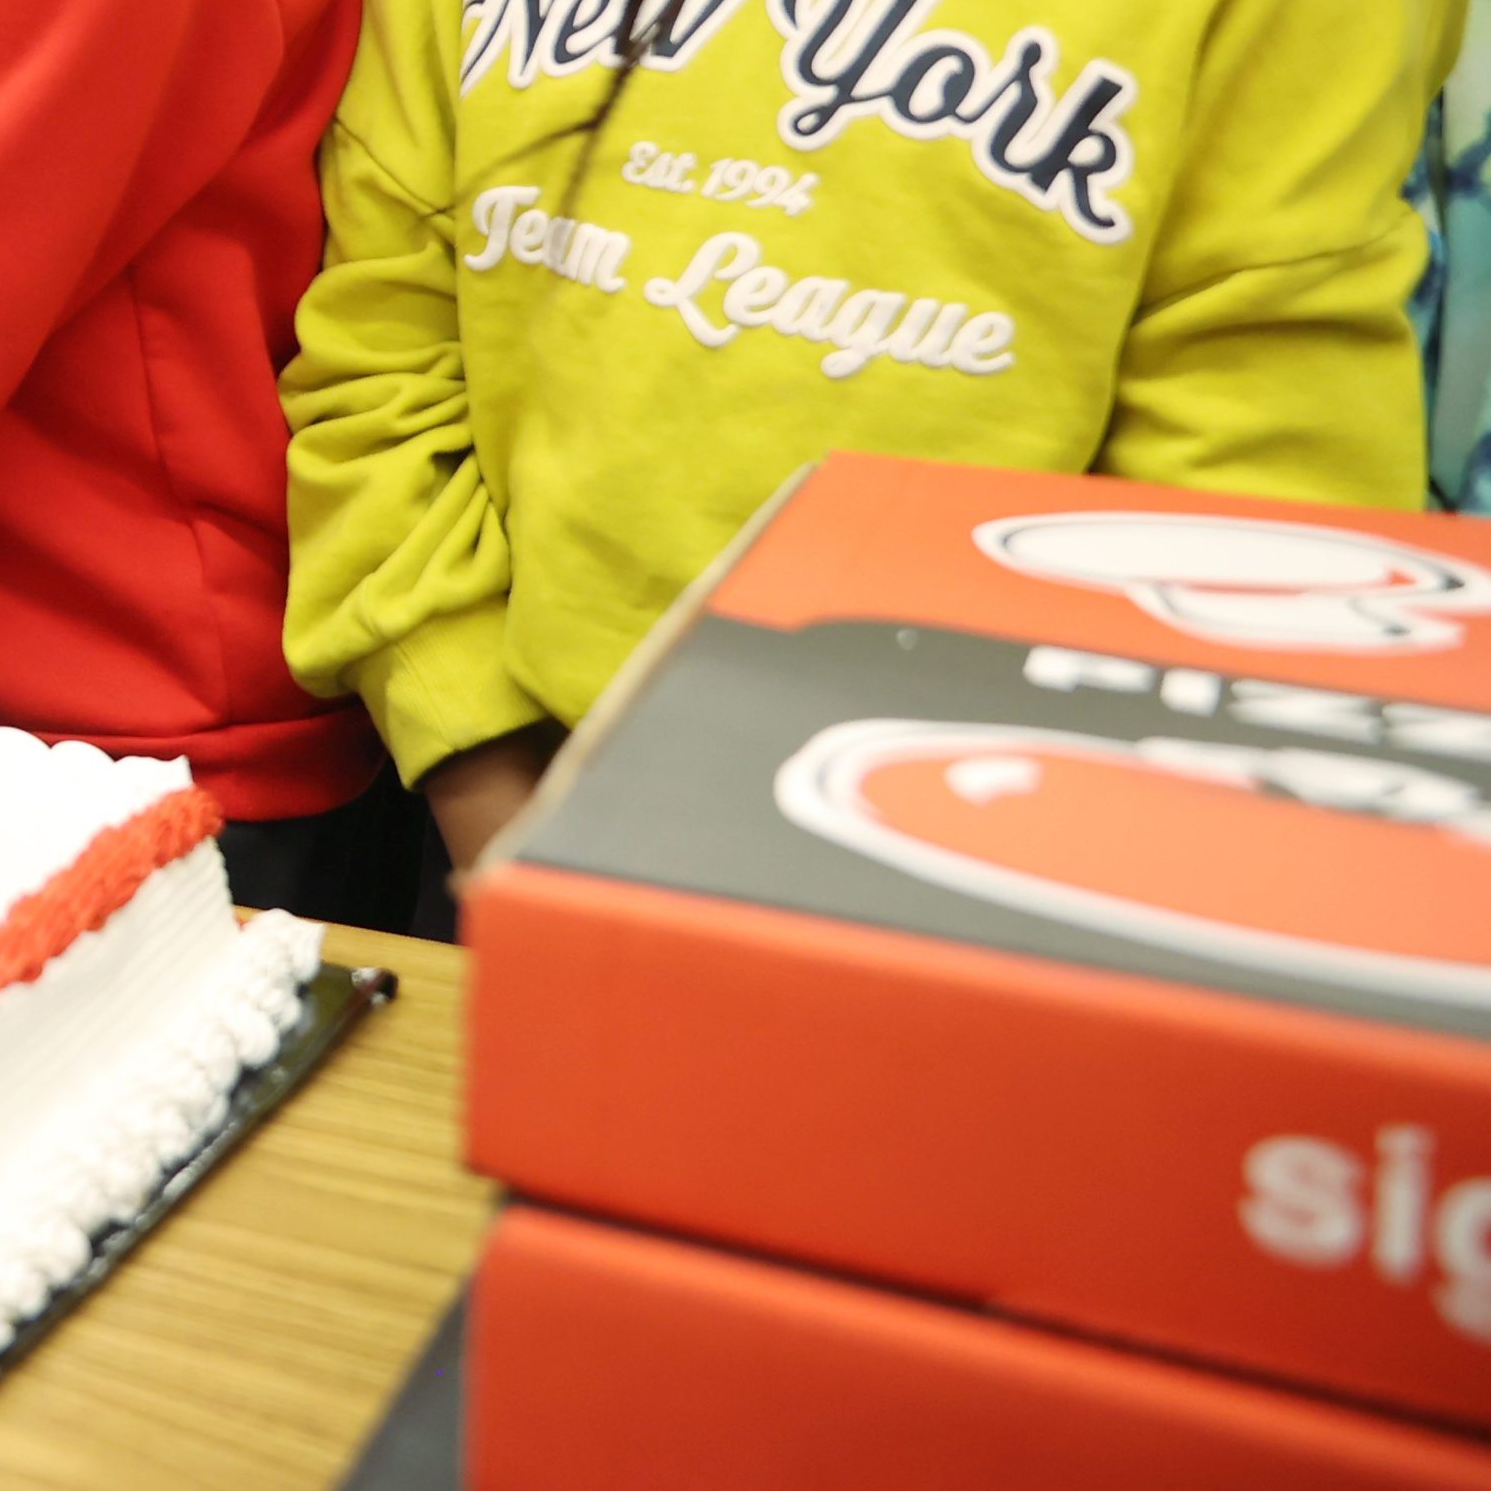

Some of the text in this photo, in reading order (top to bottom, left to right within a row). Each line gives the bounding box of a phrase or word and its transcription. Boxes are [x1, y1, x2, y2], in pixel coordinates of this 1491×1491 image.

[621, 140, 820, 216] Est. 1994
[463, 184, 1016, 379] Team League
